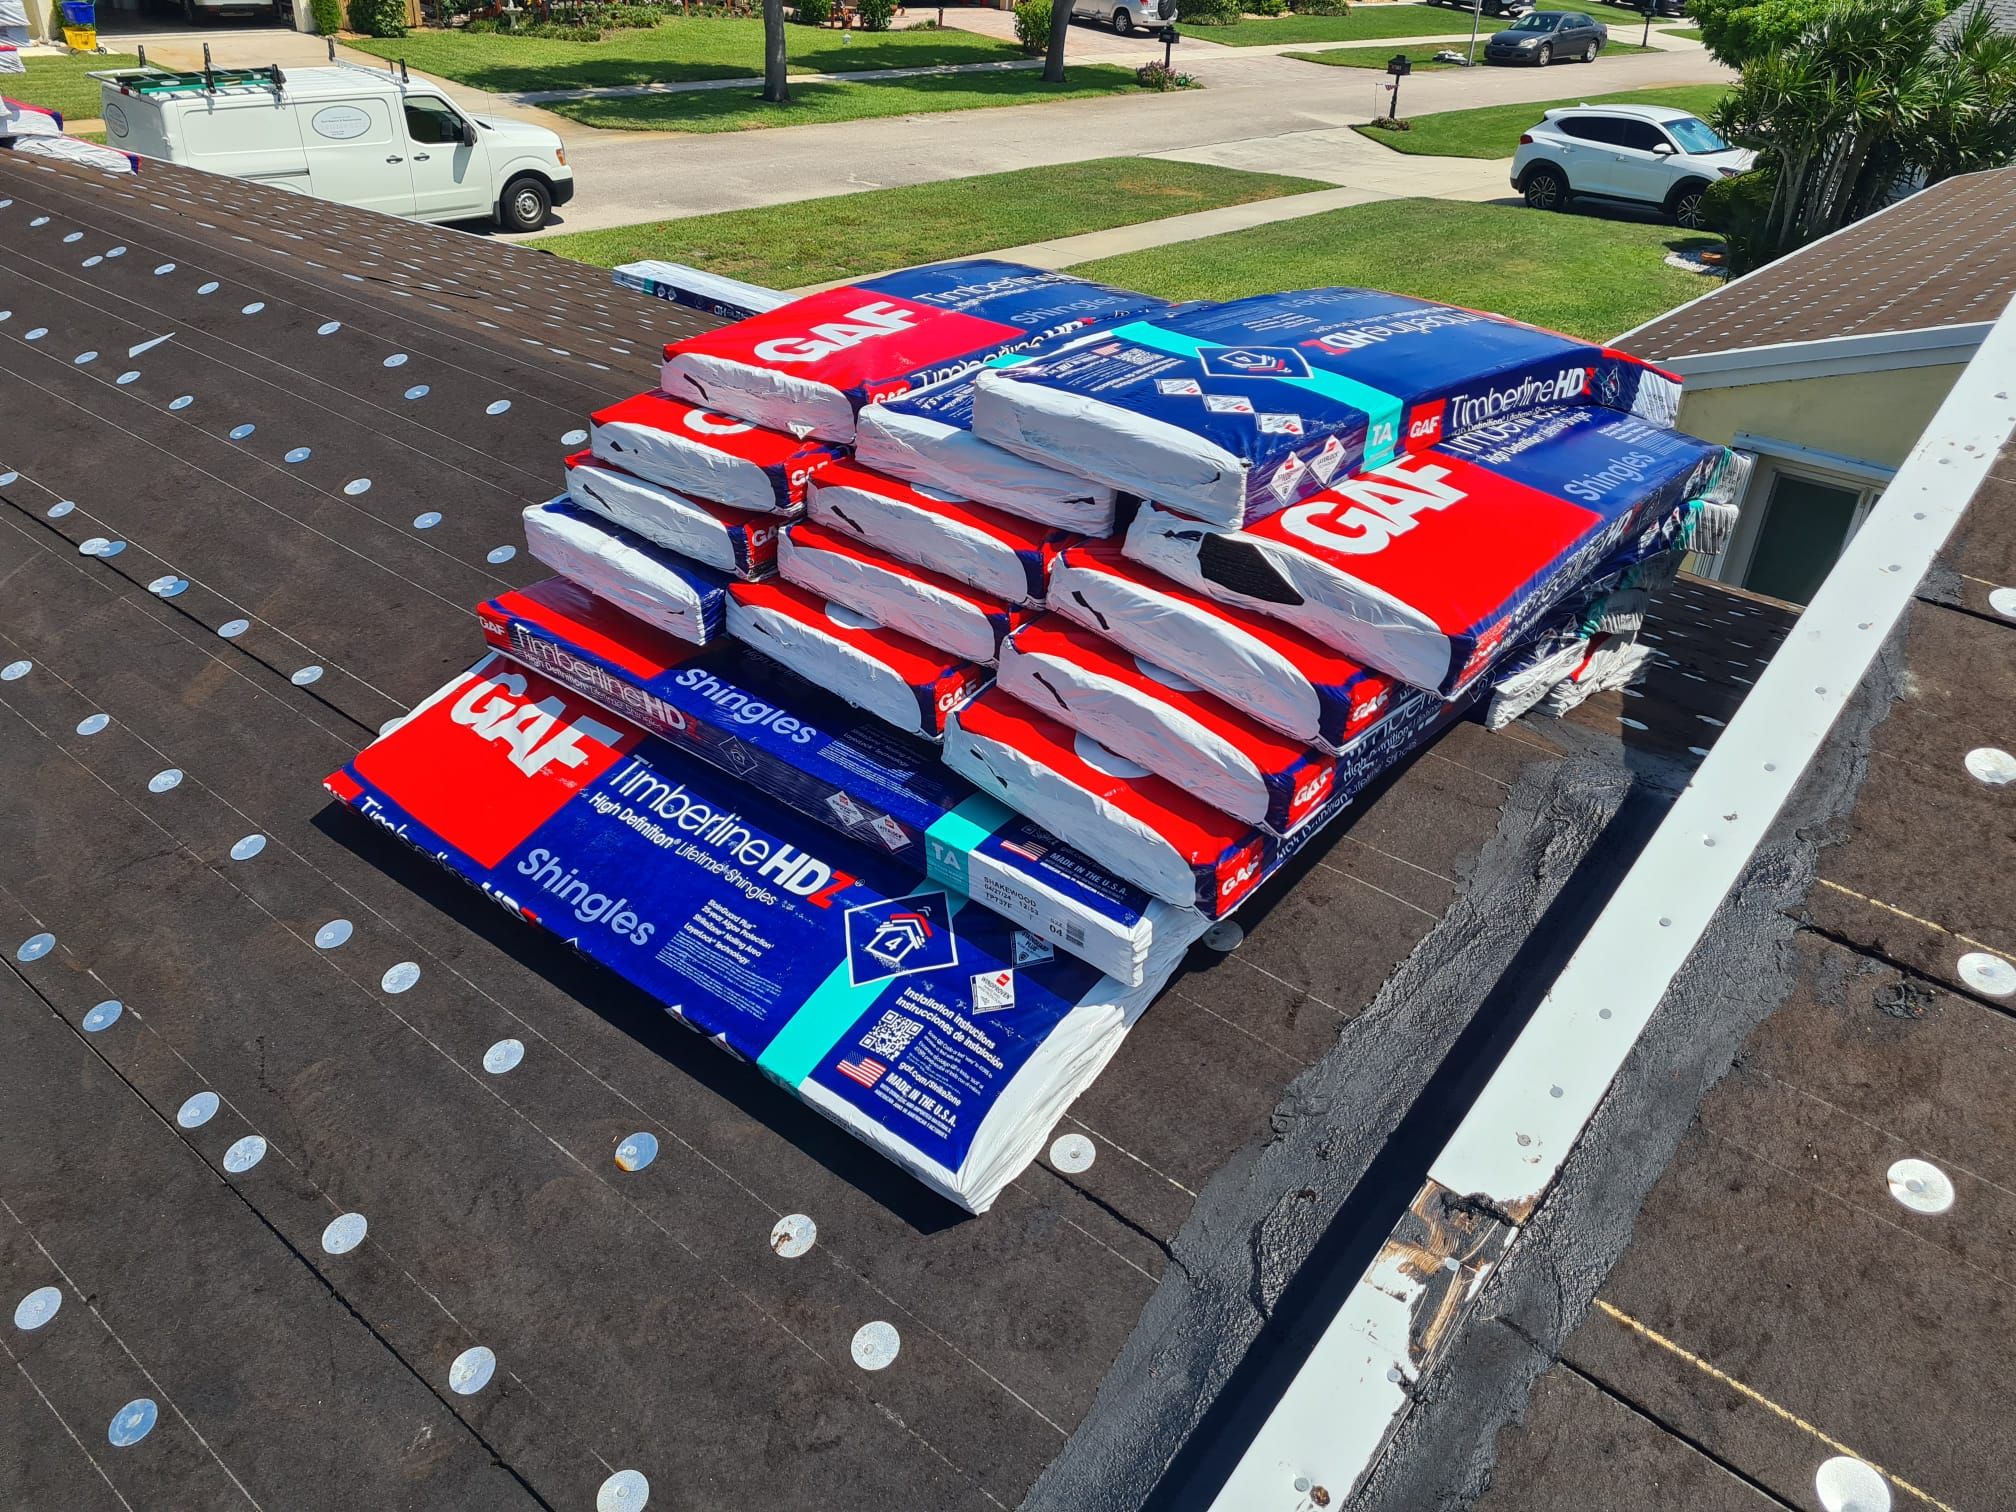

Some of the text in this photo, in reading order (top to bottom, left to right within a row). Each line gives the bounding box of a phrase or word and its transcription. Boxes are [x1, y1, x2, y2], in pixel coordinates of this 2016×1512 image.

[1010, 294, 1129, 325] Shingles
[754, 301, 915, 362] GAF
[1371, 423, 1393, 446] TA
[1410, 416, 1440, 439] GAF
[1563, 451, 1656, 501] Shingles
[1280, 454, 1469, 554] GAF
[479, 615, 506, 636] GAF
[675, 667, 818, 746] Shingles
[1352, 688, 1390, 722] GAF
[450, 673, 625, 778] GAF
[1294, 767, 1333, 806] GAF
[589, 791, 624, 815] High
[725, 867, 777, 906] Shingles
[931, 842, 961, 870] TA
[983, 876, 1037, 907] SHAKEWOOD
[1050, 852, 1074, 870] MADE
[1074, 865, 1086, 875] IN
[1085, 869, 1102, 883] THE
[1101, 878, 1129, 897] U.S.A.
[1221, 857, 1261, 896] GAF
[518, 848, 656, 947] Shingles
[721, 918, 741, 933] Algae
[1049, 925, 1064, 937] 04
[714, 941, 751, 965] Technology
[745, 944, 762, 957] Area
[885, 935, 900, 951] 4
[903, 987, 955, 1020] Installation
[895, 997, 954, 1036] Instrucciones
[952, 1031, 966, 1042] de
[963, 1037, 1004, 1070] instalación
[886, 1072, 957, 1128] MADE IN THE U.S.A.
